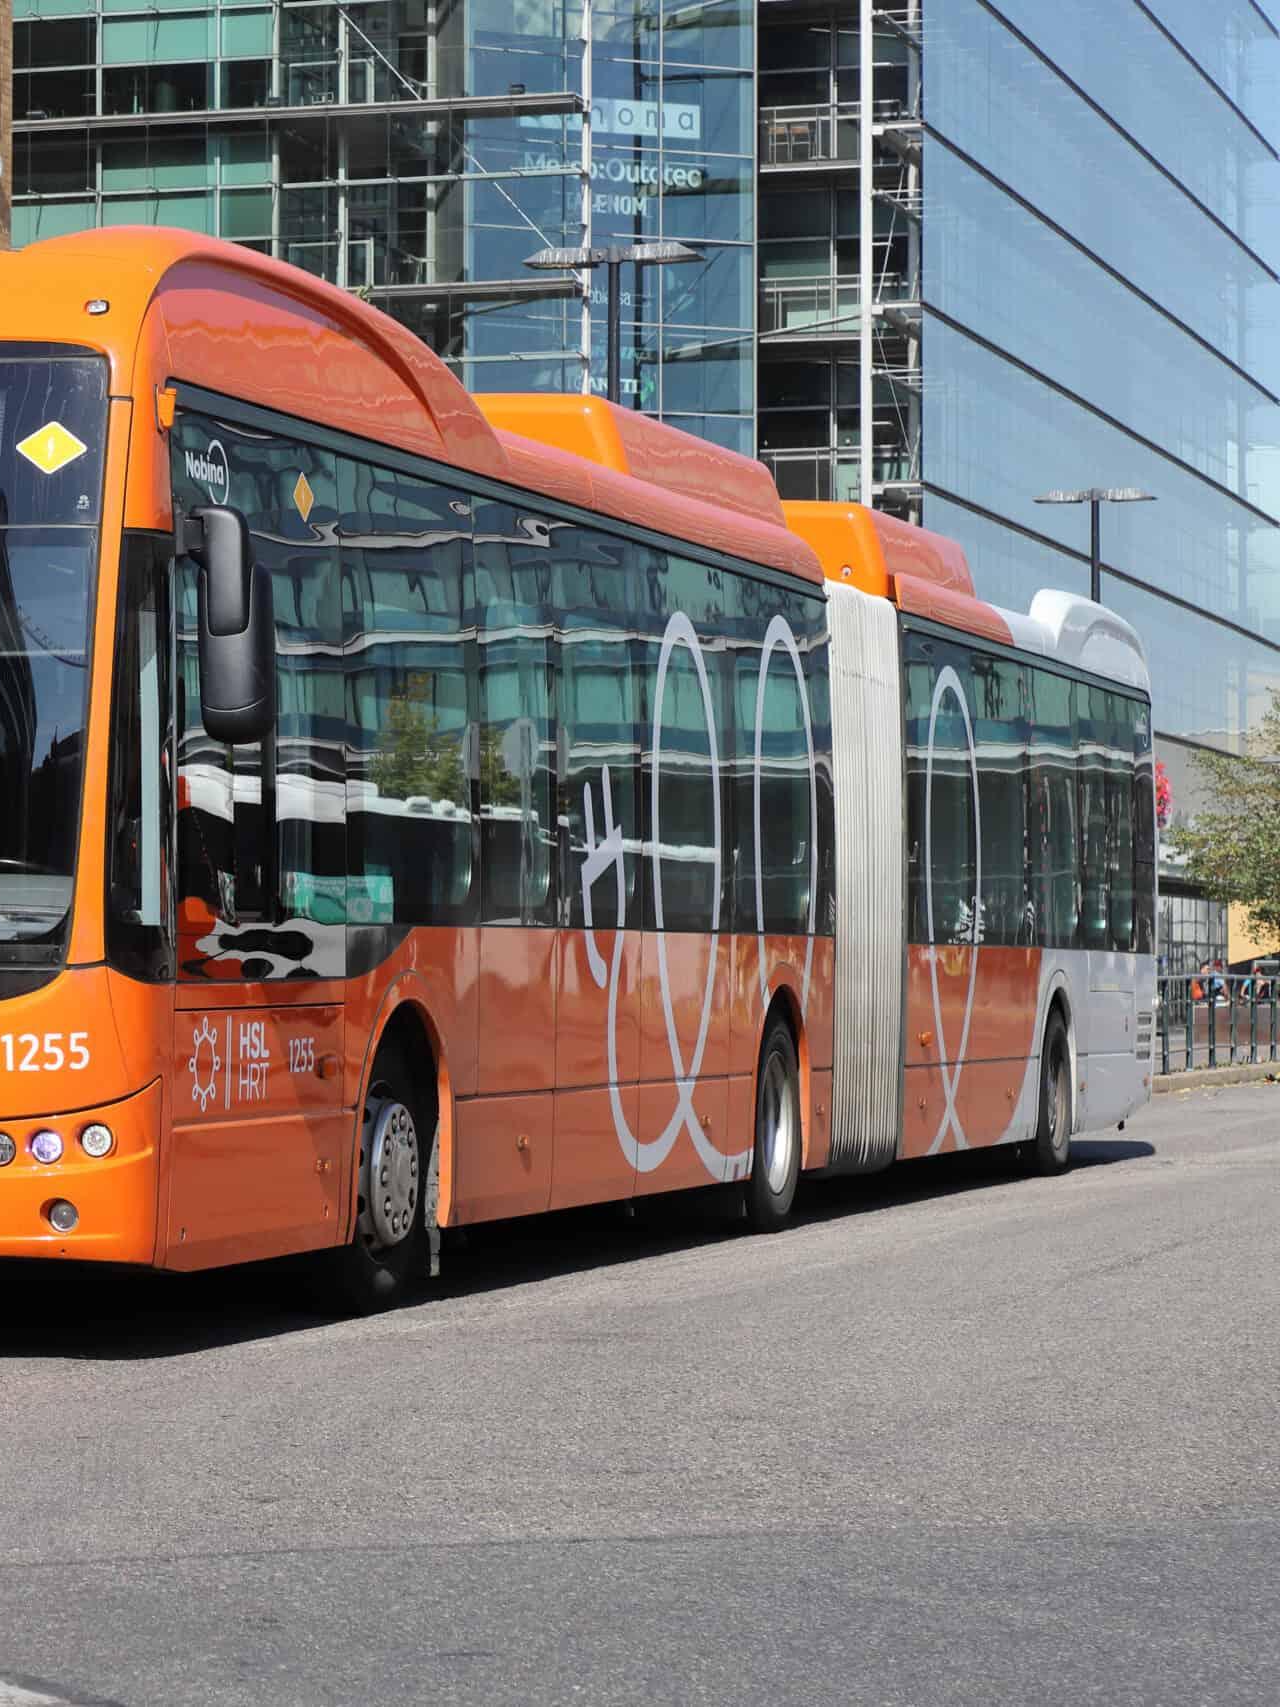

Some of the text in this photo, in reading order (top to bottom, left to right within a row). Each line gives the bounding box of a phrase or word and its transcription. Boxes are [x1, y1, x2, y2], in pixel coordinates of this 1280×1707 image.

[184, 450, 225, 486] Nobina
[0, 1032, 91, 1072] 1255
[239, 1022, 270, 1060] HSL
[288, 1037, 315, 1073] 1255
[238, 1062, 271, 1102] HRT
